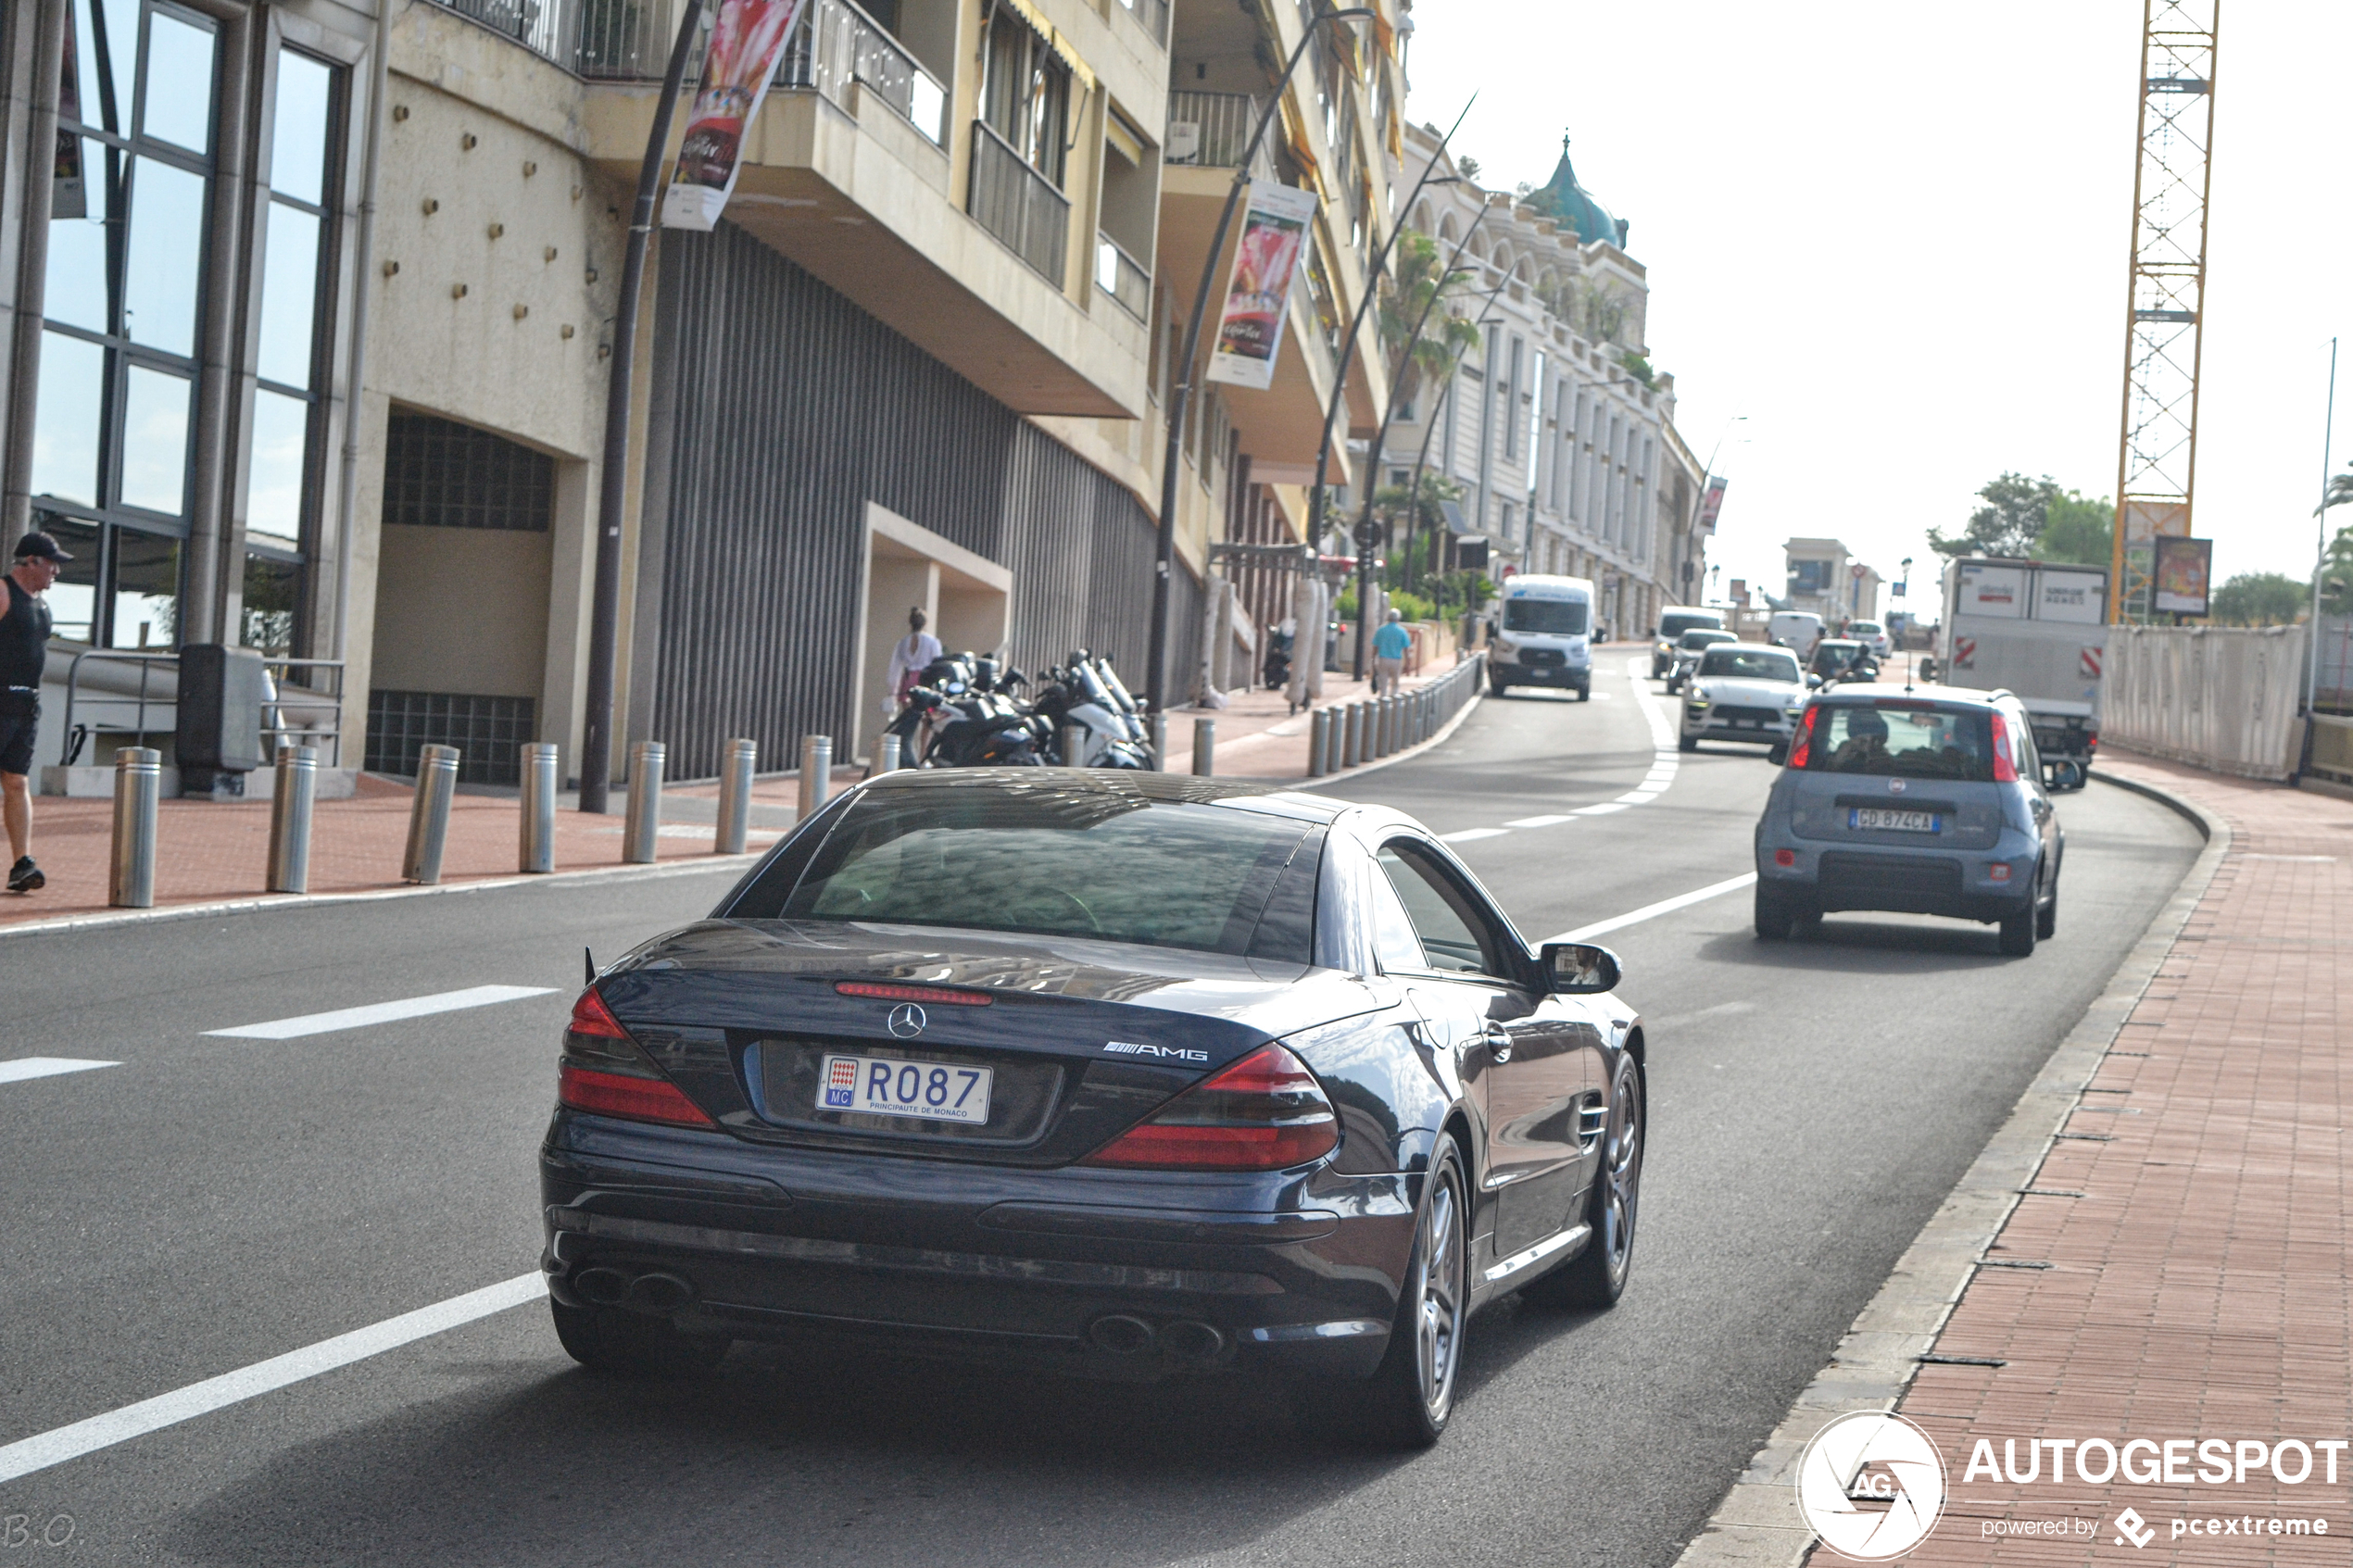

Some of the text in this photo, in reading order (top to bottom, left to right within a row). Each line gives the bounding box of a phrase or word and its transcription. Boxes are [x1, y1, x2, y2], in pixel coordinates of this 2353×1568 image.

[1883, 812, 1931, 830] 874CA
[1136, 1045, 1208, 1061] AMG
[831, 1090, 849, 1105] MC
[869, 1102, 918, 1113] PRINCIPAUTE
[934, 1108, 968, 1118] MONACO
